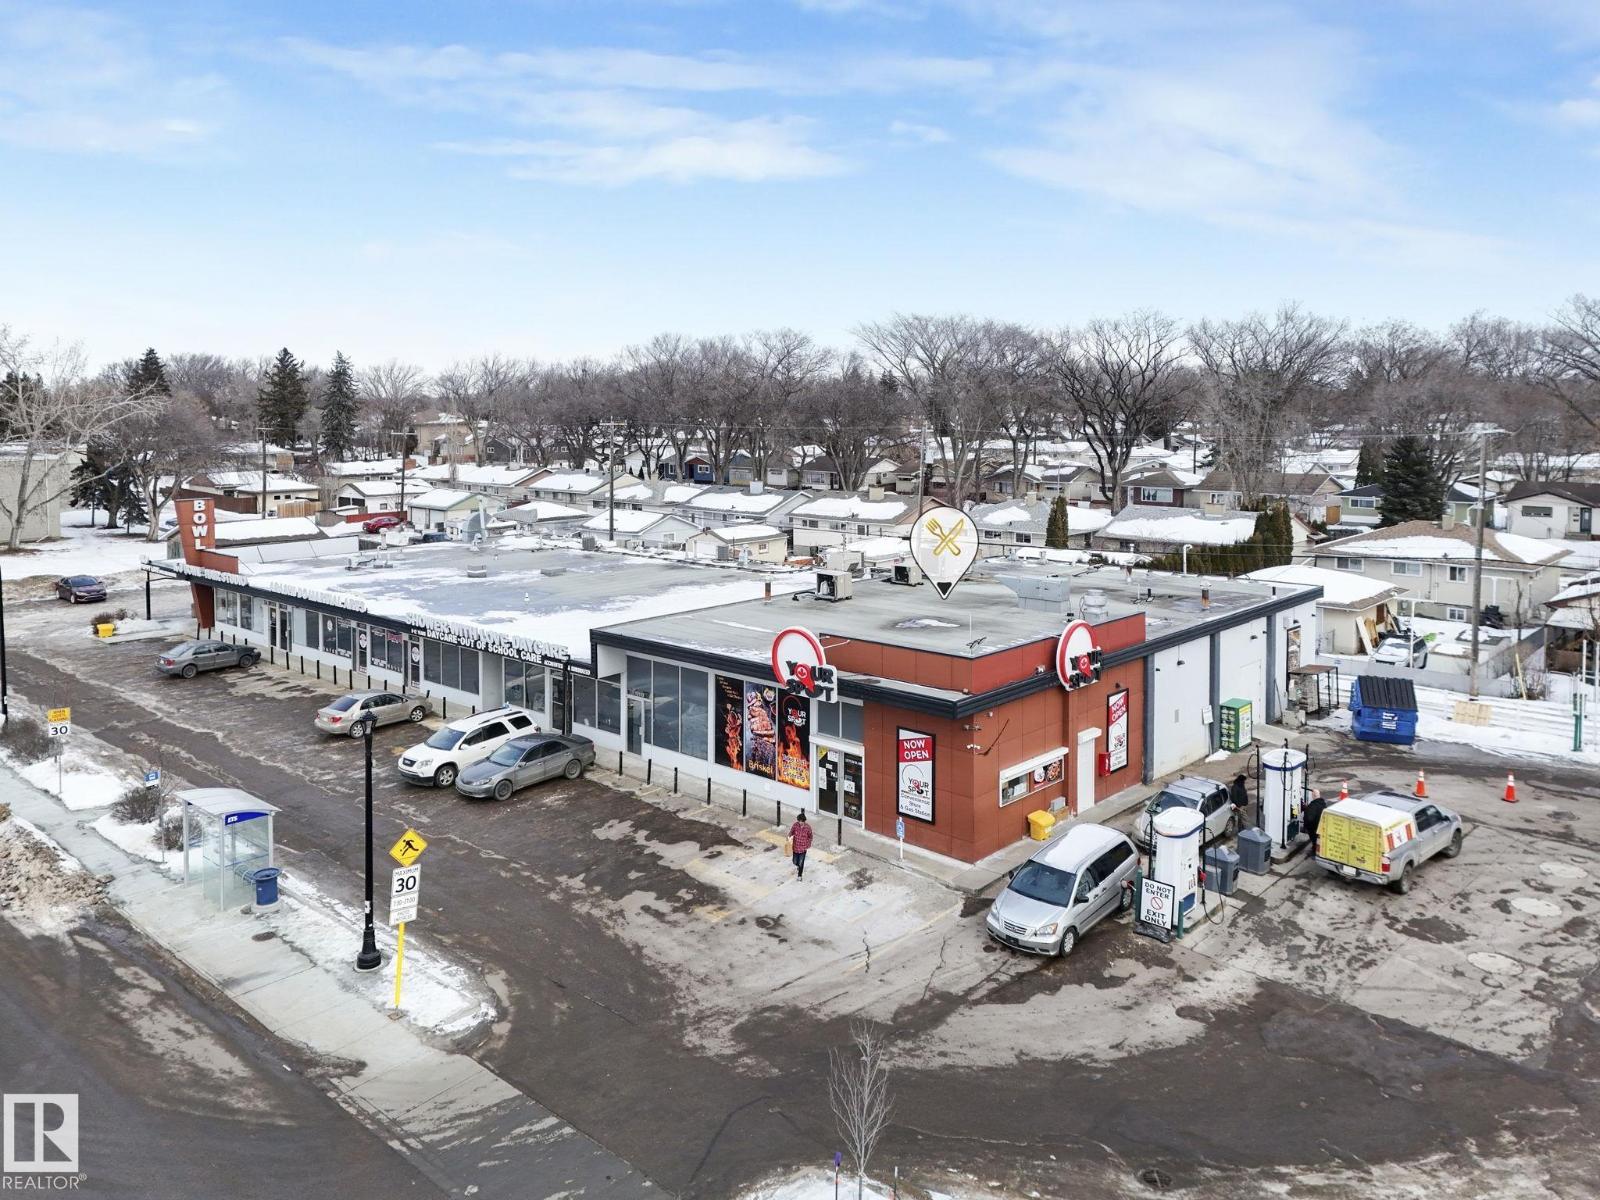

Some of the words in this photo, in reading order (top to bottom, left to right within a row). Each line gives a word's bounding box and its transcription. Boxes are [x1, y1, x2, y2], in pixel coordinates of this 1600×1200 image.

[191, 500, 208, 550] BOWL
[427, 629, 458, 644] DAYCARE
[460, 636, 475, 648] OUT
[476, 641, 486, 651] OF
[488, 643, 519, 659] SCHOOL
[520, 651, 542, 664] CARE
[512, 636, 570, 661] DAYCARE
[786, 678, 835, 702] SPOT
[1111, 696, 1125, 713] NOW
[1111, 705, 1127, 722] OPEN
[51, 725, 68, 736] 30
[903, 740, 925, 749] NOW
[904, 750, 929, 760] OPEN
[908, 777, 929, 789] YOUR
[908, 785, 929, 797] SPOT
[395, 875, 416, 893] 30
[1144, 881, 1155, 889] DO
[1156, 885, 1171, 894] NOT
[1145, 887, 1170, 899] ENTER
[1146, 908, 1166, 920] EXIT
[1144, 915, 1167, 927] ONLY
